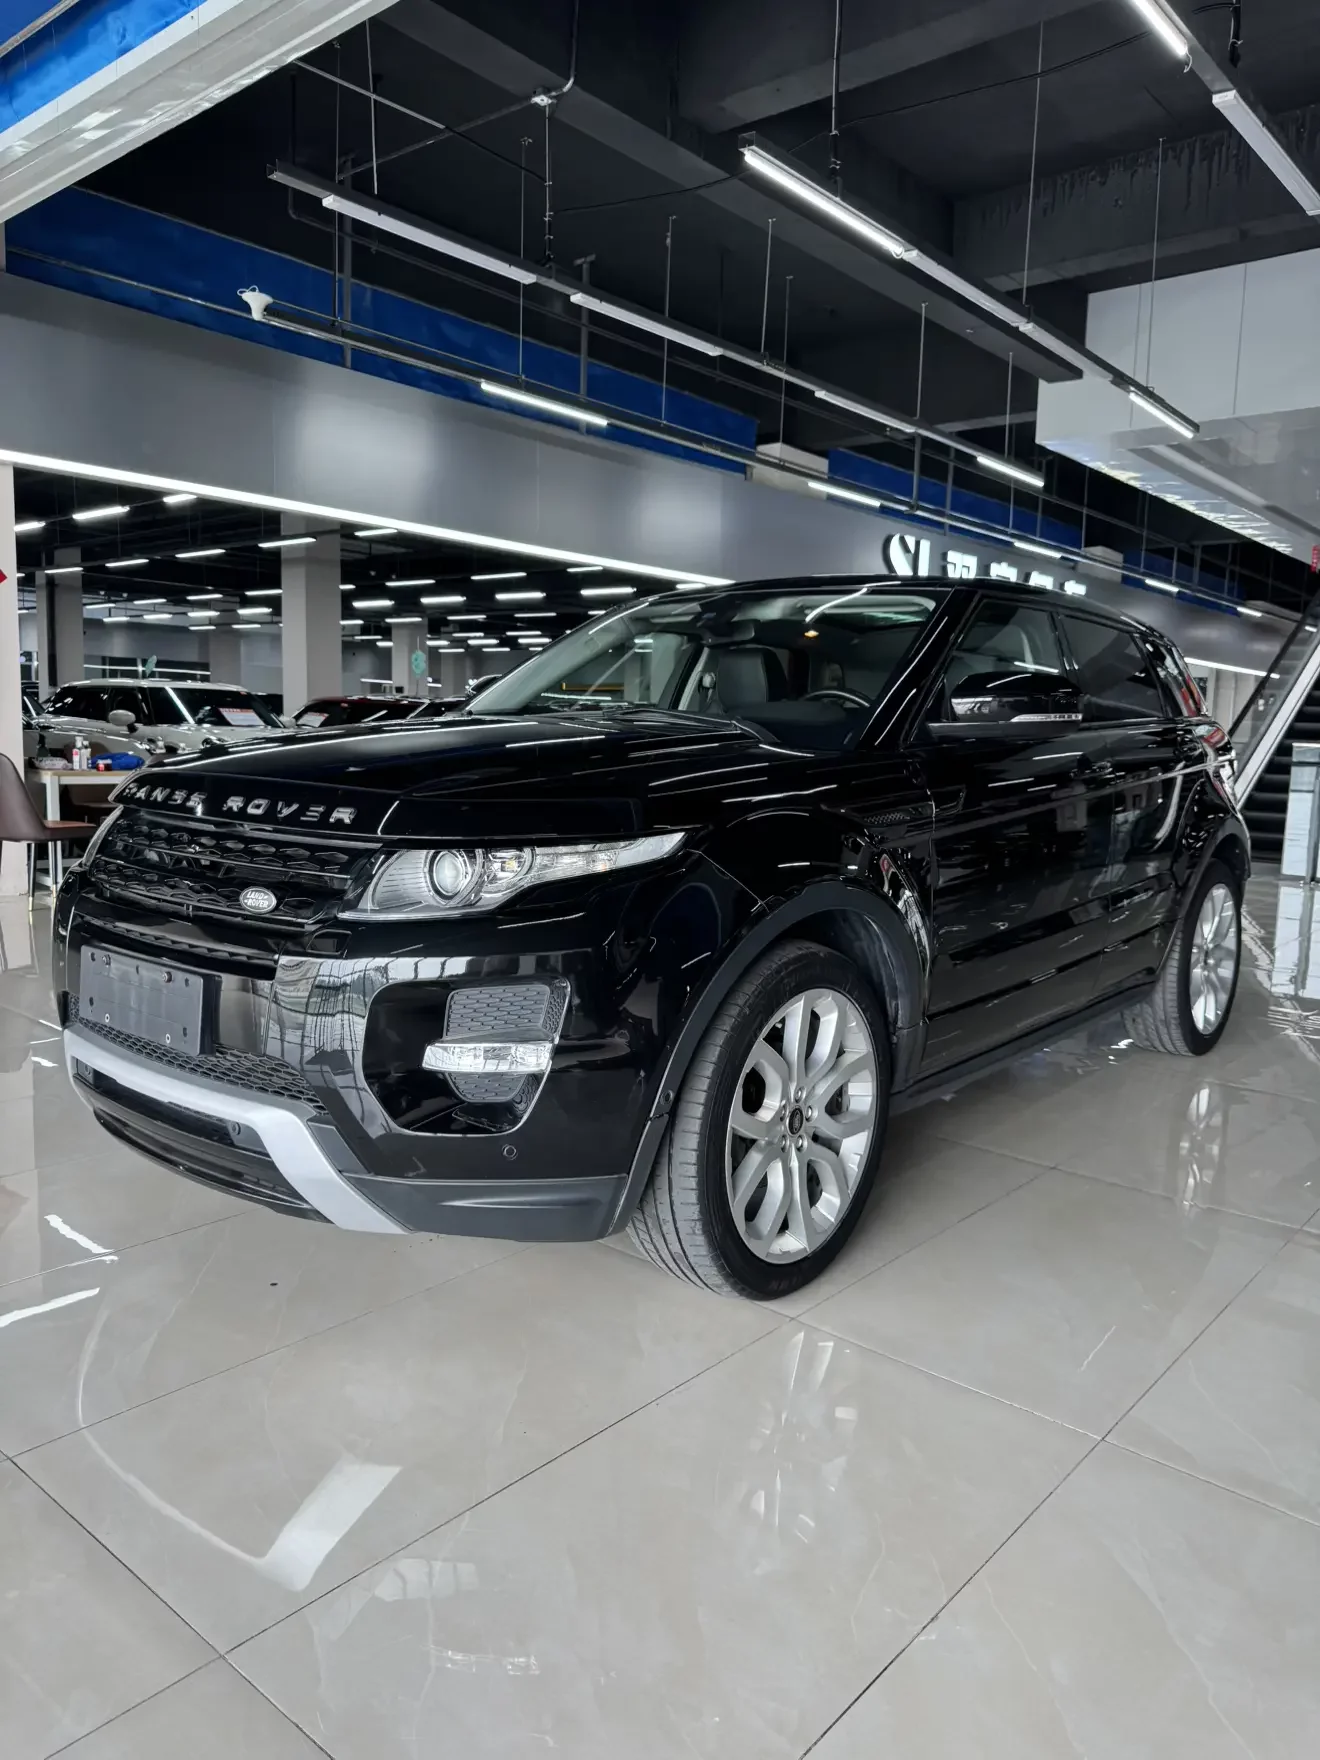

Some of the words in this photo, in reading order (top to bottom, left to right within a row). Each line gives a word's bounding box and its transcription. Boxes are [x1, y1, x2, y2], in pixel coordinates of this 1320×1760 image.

[122, 782, 208, 810] RANGE
[222, 795, 358, 825] ROVER
[246, 890, 265, 900] LAND
[247, 899, 269, 908] ROVER
